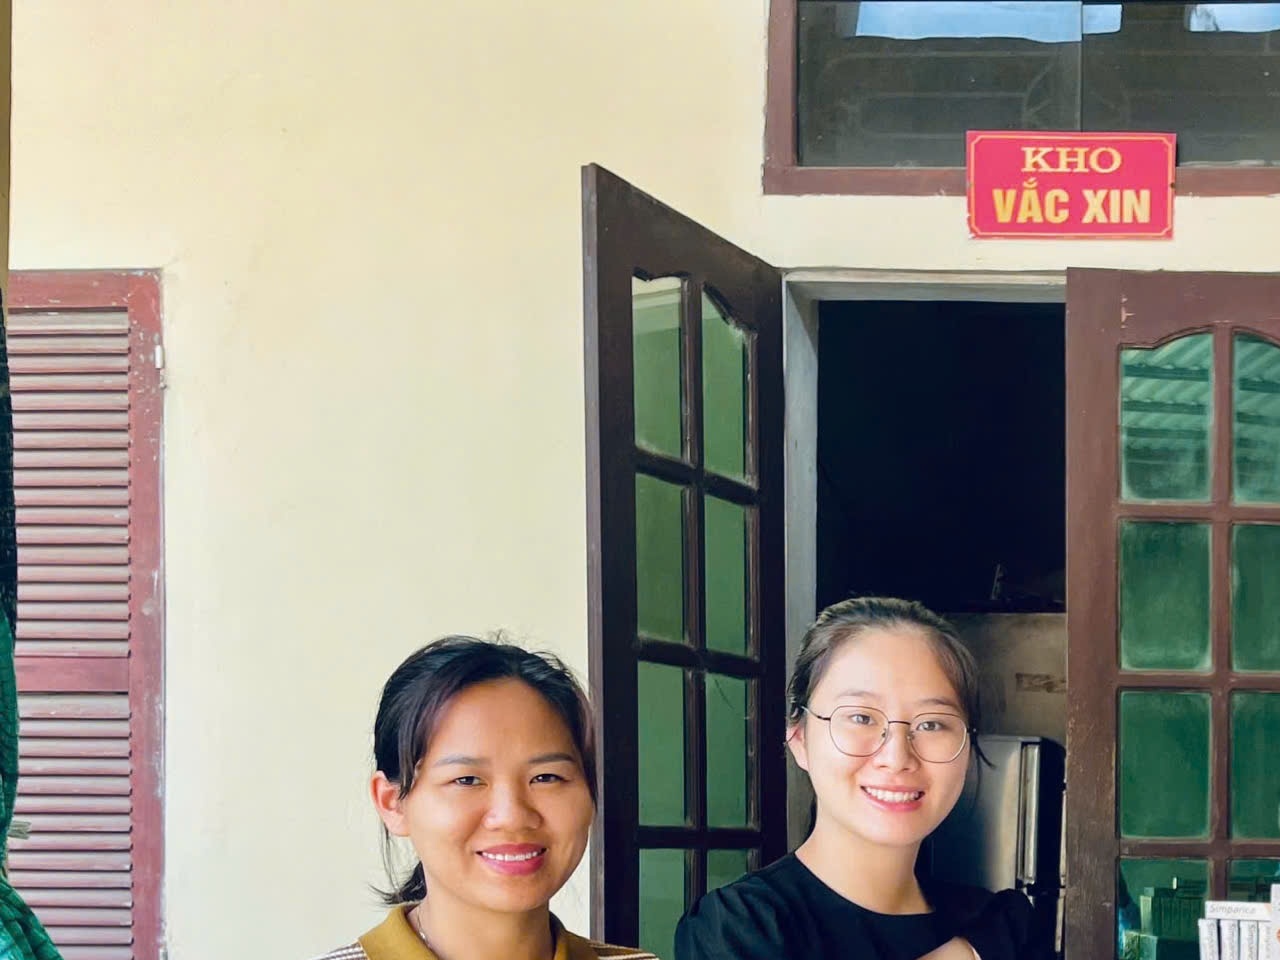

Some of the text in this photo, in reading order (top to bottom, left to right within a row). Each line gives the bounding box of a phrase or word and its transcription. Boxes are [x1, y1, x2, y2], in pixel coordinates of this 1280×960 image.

[1021, 146, 1122, 173] KHO
[992, 177, 1150, 224] VẮC XIN
[1209, 903, 1256, 915] Simparica
